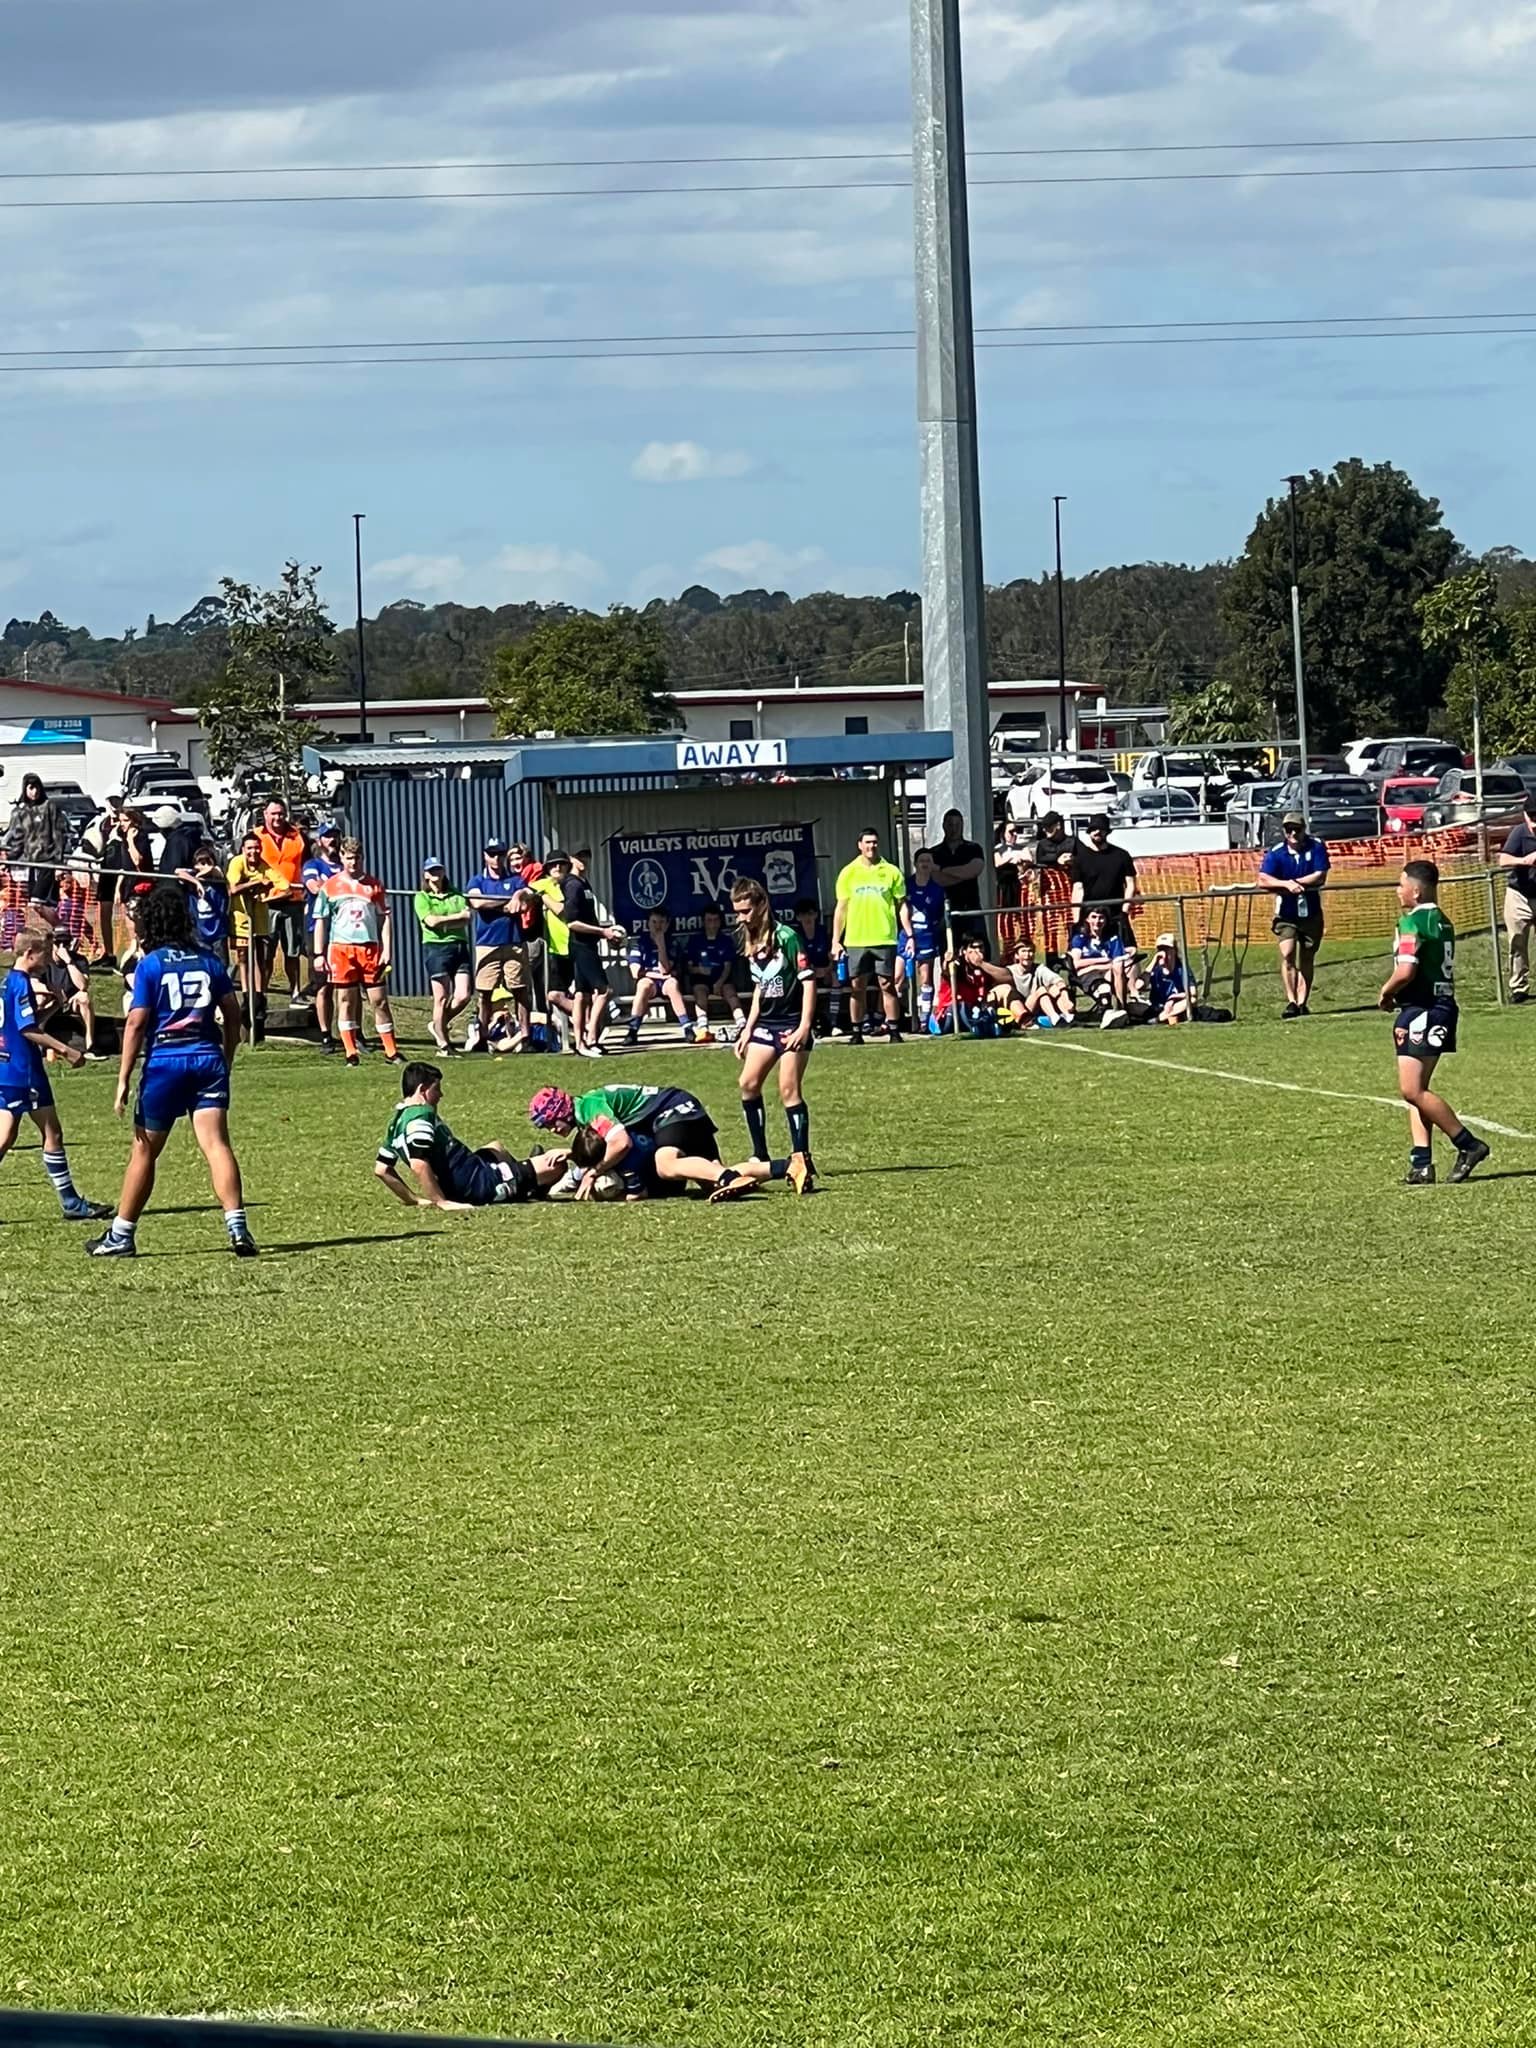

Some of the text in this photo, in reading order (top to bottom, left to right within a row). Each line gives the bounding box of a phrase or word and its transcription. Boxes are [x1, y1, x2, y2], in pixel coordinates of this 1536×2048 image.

[683, 742, 782, 766] AWAY 1
[618, 828, 804, 854] VALLEYS RUGBY LEAGUE
[160, 970, 212, 1011] 13
